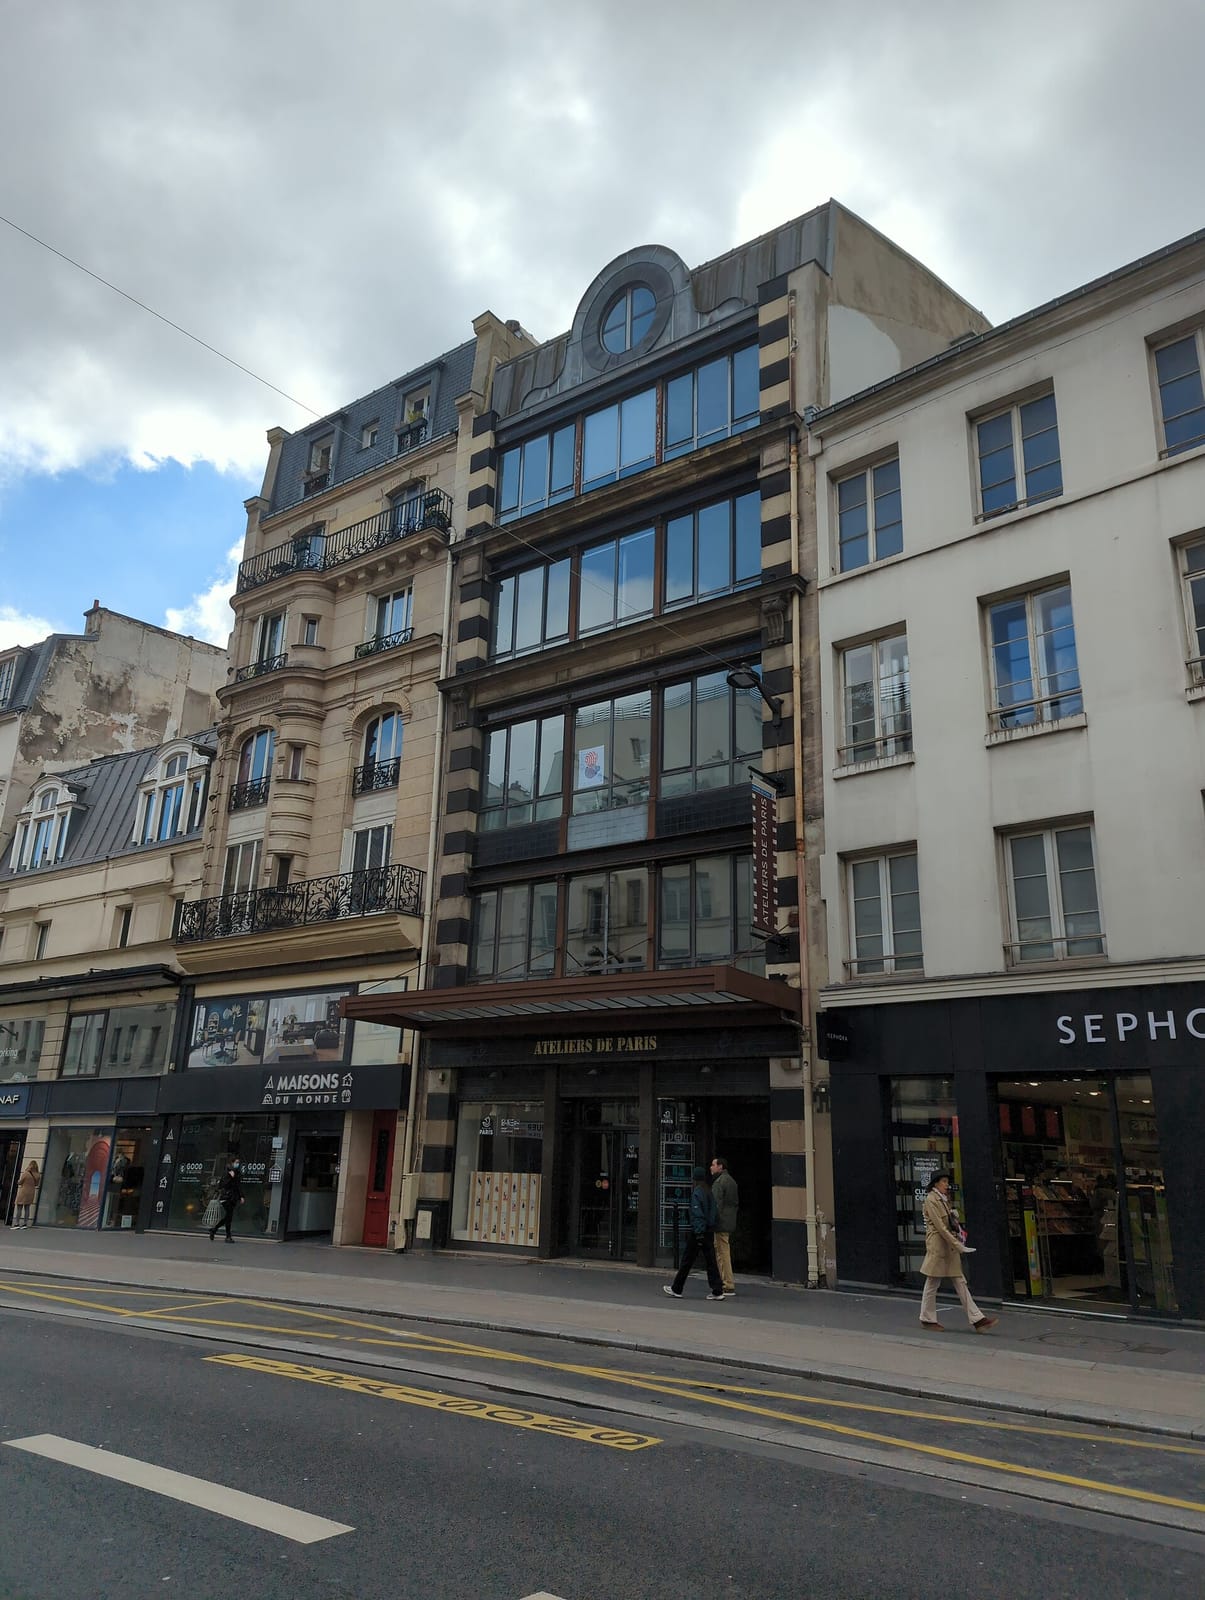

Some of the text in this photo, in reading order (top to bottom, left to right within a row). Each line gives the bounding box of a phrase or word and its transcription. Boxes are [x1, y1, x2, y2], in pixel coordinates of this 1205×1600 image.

[760, 797, 768, 837] PARIS
[761, 839, 768, 858] DE
[761, 860, 769, 926] ATELIERS
[533, 1035, 657, 1055] ATELIERS DE PARIS
[276, 1073, 339, 1090] MAISONS
[275, 1094, 338, 1104] DU MONDE
[210, 1353, 648, 1446] LIVRAISONS
